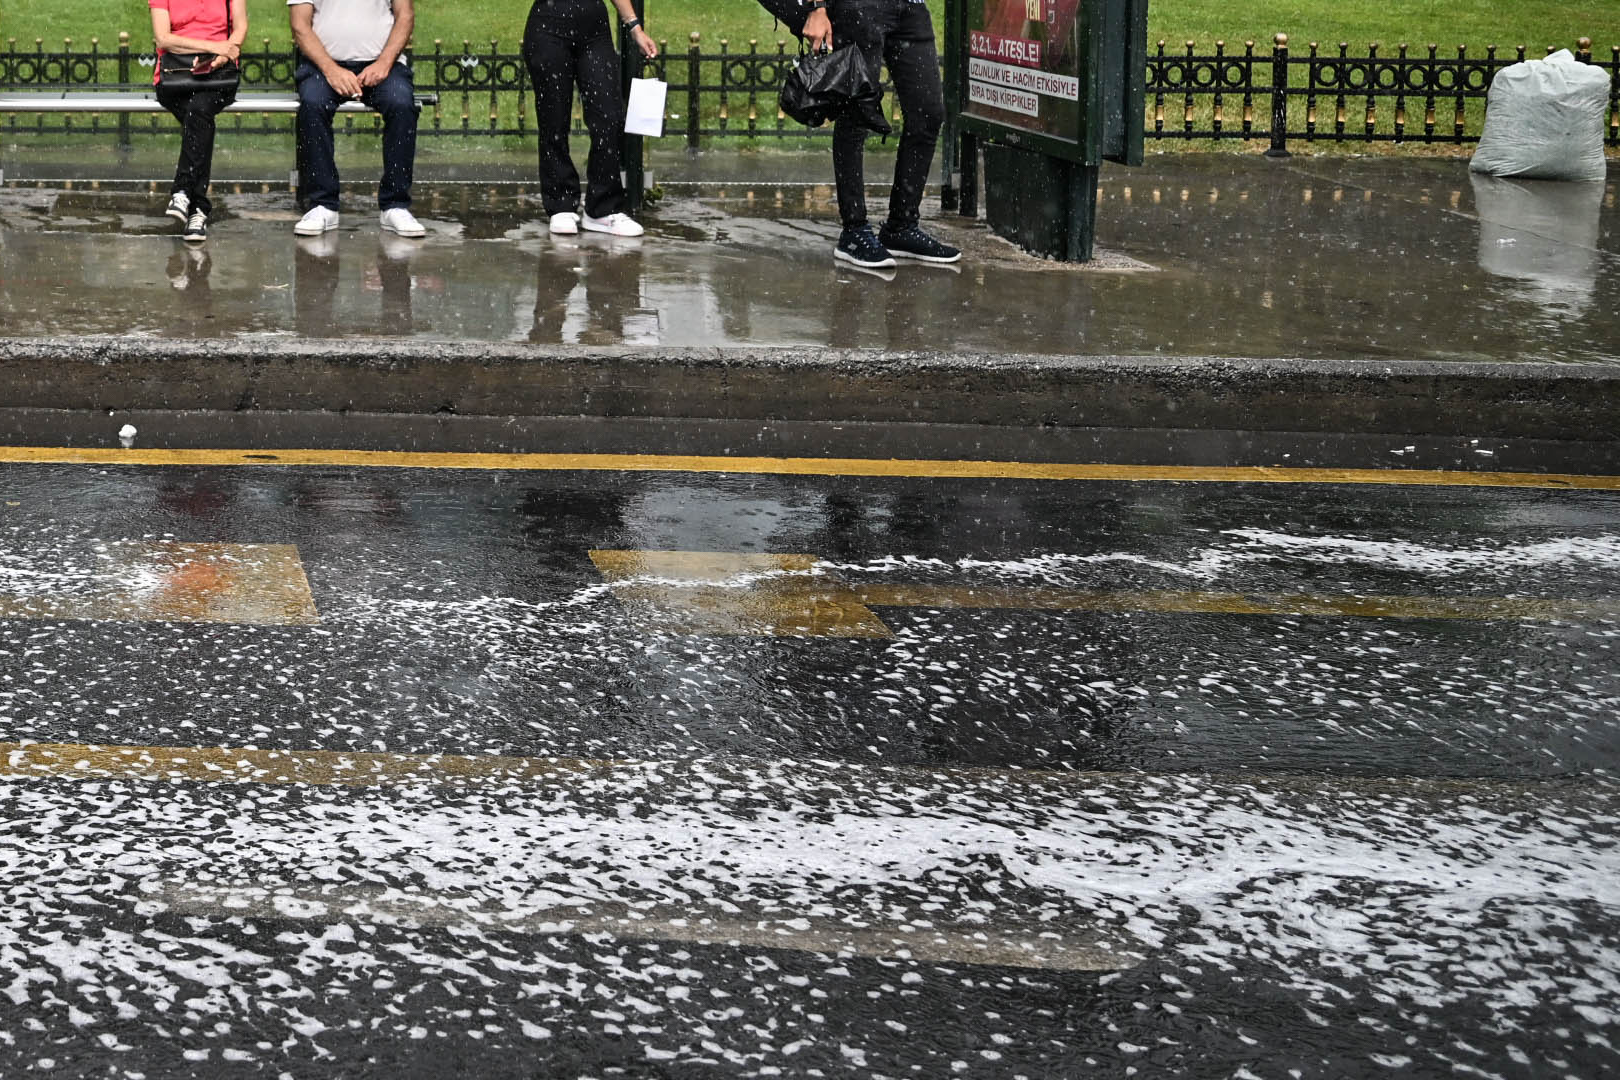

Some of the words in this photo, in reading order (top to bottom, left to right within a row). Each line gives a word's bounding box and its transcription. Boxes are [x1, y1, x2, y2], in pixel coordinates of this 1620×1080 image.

[997, 38, 1040, 64] ATEŞLE!
[970, 63, 1000, 80] UZUNLUK
[1001, 69, 1011, 83] VE
[1012, 71, 1036, 88] HACİM
[1036, 75, 1077, 97] ETKİSİYLE
[971, 84, 985, 98] SIRA
[986, 88, 999, 104] DIŞI
[1000, 89, 1037, 112] KİRPİKLER
